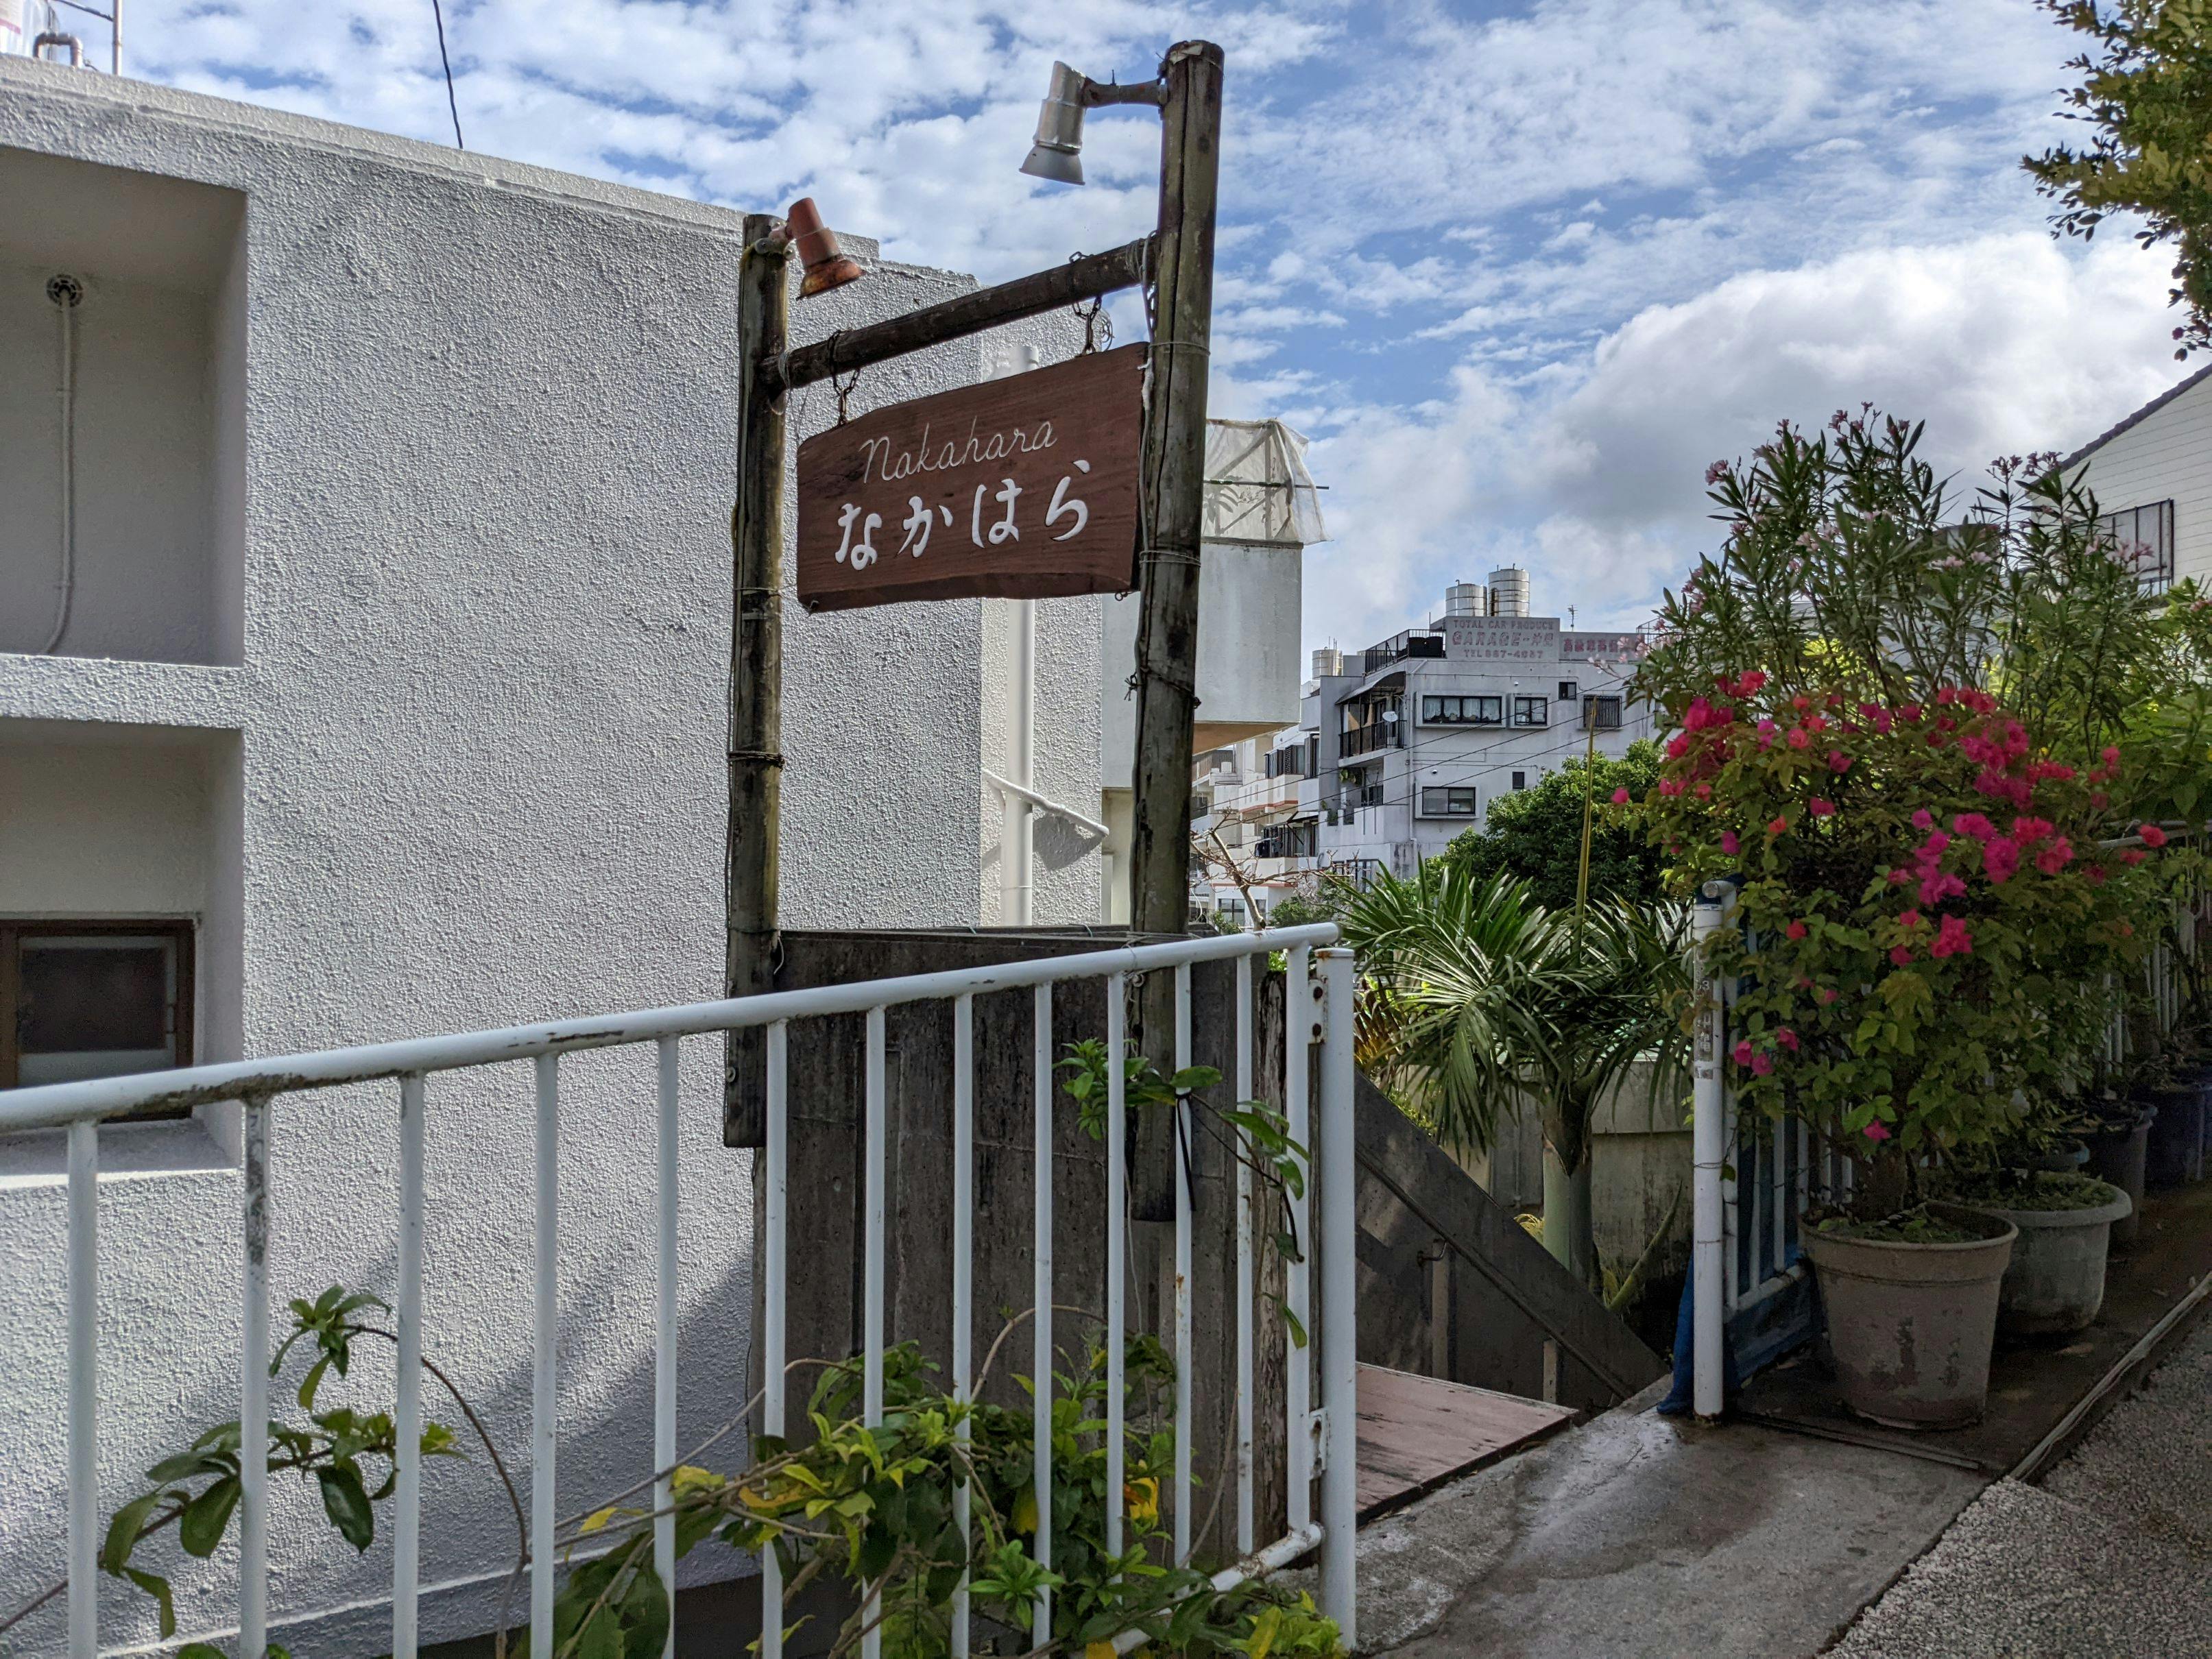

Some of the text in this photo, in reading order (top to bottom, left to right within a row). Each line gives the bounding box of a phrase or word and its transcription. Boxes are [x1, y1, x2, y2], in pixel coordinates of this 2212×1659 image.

[858, 416, 1057, 483] Nakahara
[834, 459, 1092, 571] なかはら
[1454, 619, 1554, 629] TOTAL CAR PRODUCE
[1464, 649, 1482, 658] TEL
